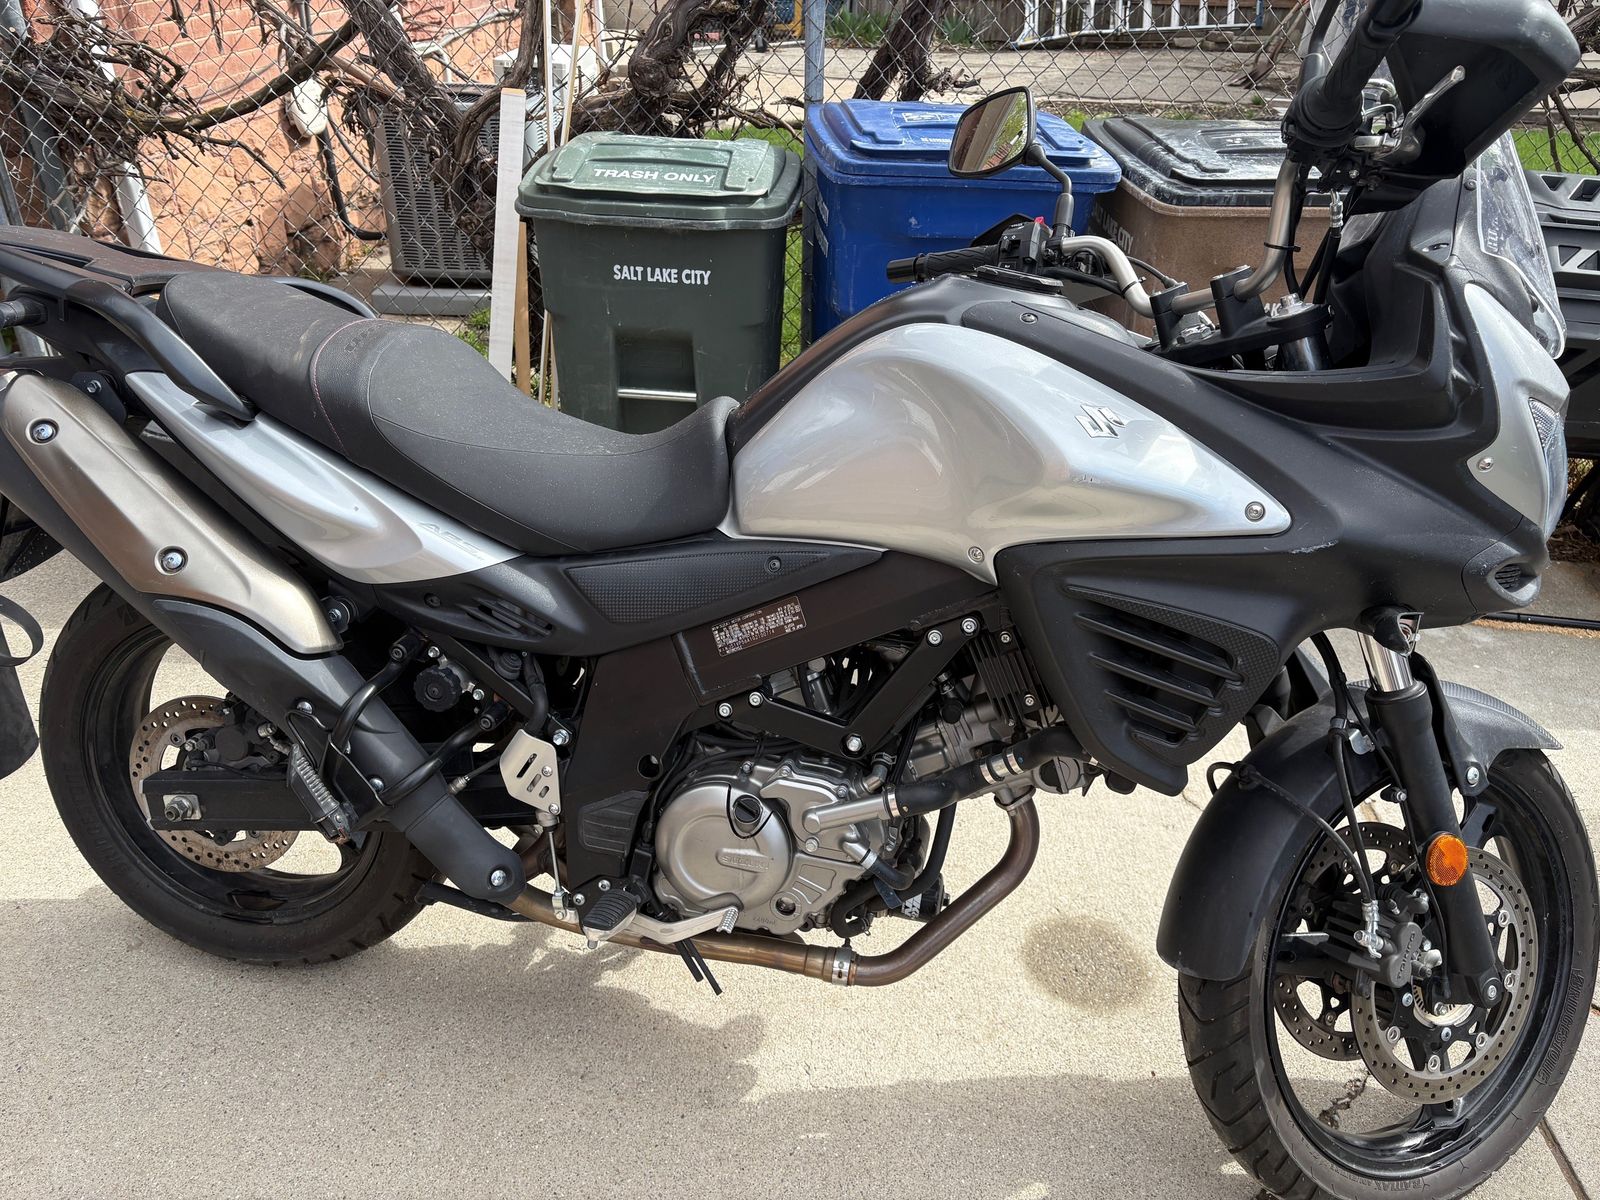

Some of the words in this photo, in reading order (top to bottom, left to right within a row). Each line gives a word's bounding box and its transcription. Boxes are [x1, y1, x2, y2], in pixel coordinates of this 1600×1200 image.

[594, 168, 659, 180] TRASH
[664, 172, 717, 183] ONLY
[613, 264, 644, 281] SALT
[646, 266, 678, 283] LAKE
[681, 269, 711, 286] CITY
[1539, 969, 1585, 1085] BRIDGESTONE
